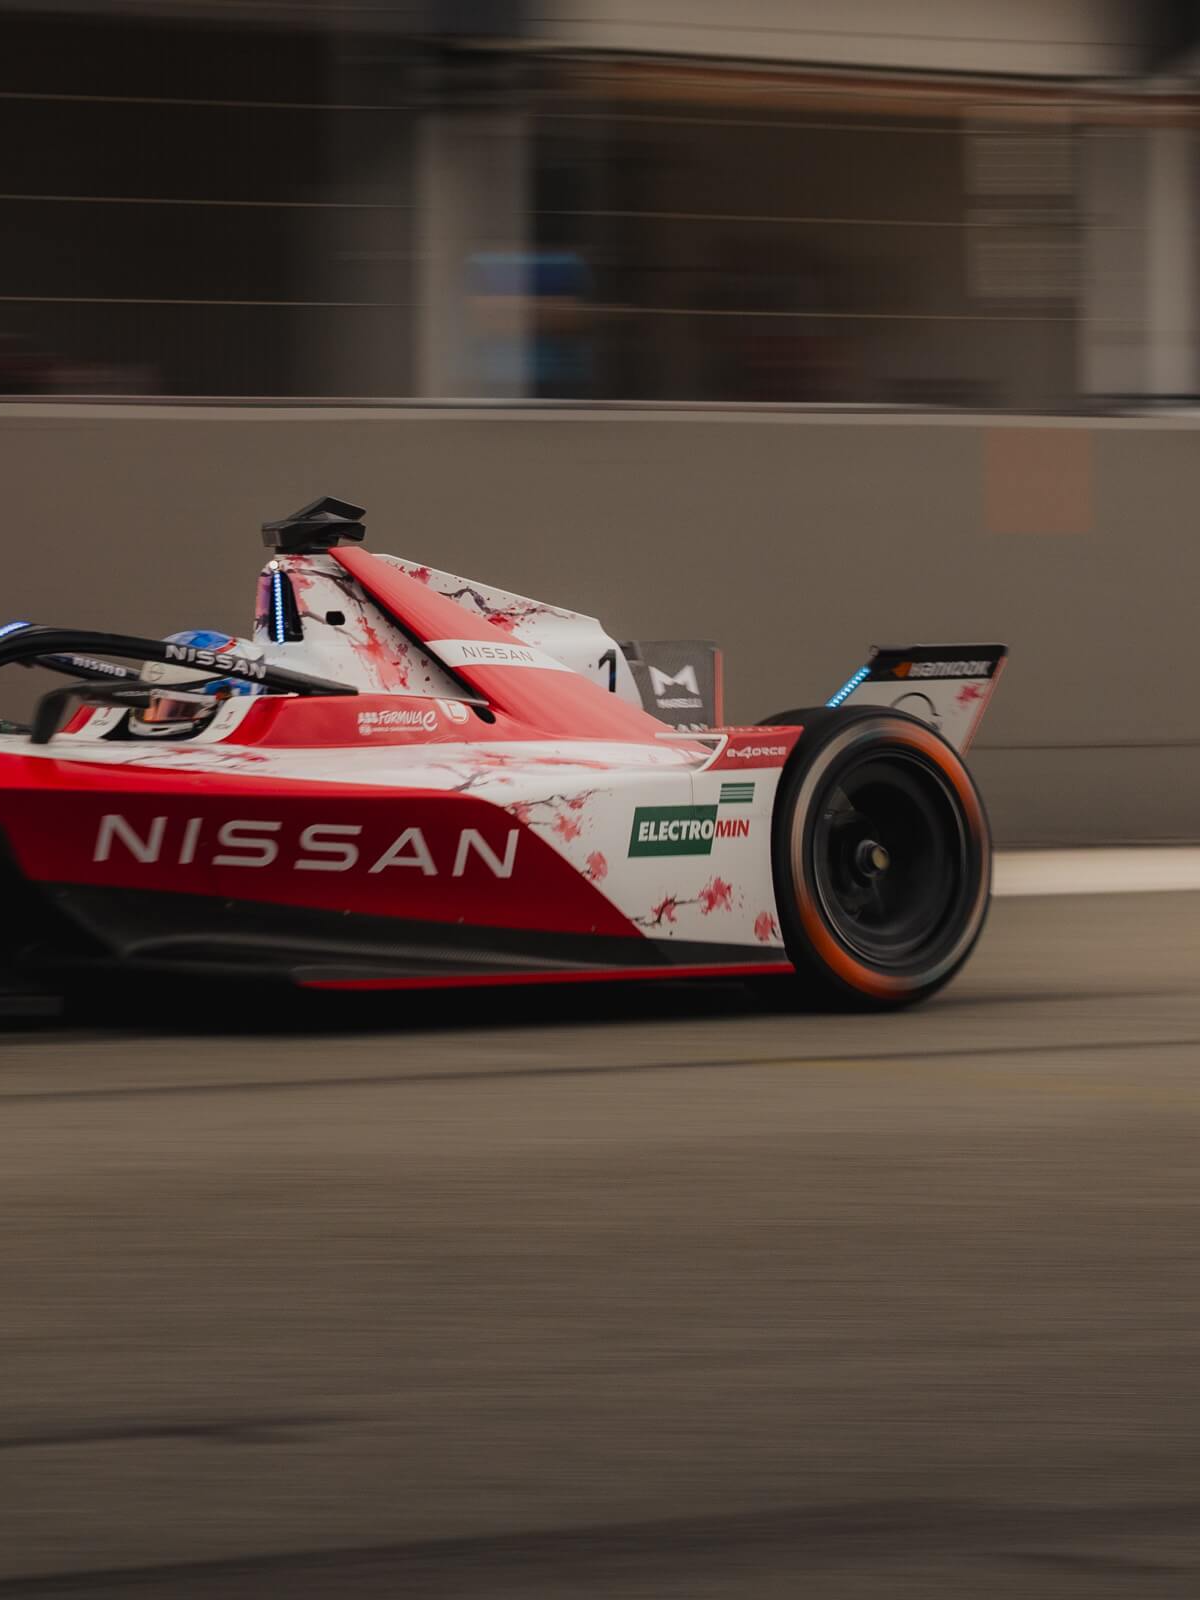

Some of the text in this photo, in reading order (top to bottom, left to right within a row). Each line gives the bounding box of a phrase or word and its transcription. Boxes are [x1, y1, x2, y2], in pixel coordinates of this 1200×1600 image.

[164, 644, 267, 680] NISSAN
[461, 645, 534, 662] NISSAN
[598, 649, 617, 692] 1
[93, 814, 520, 879] NISSAN
